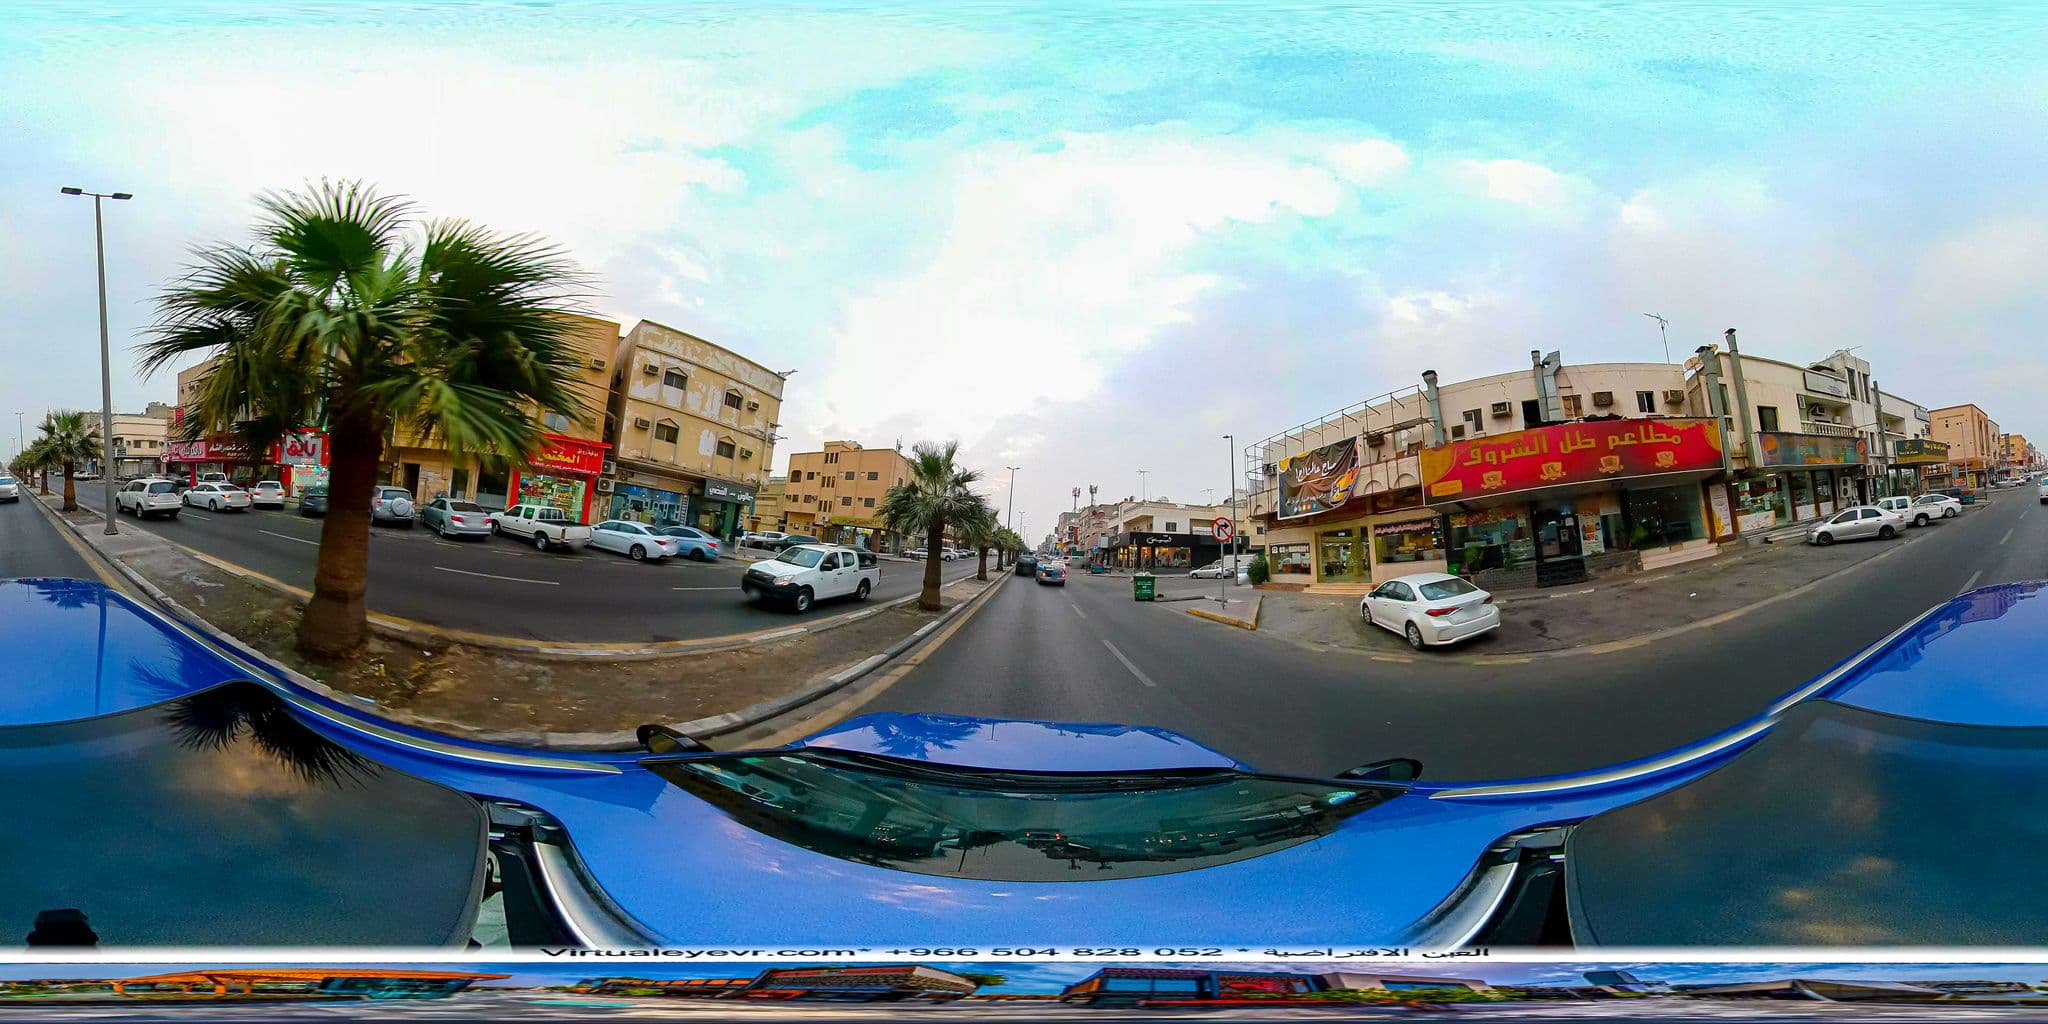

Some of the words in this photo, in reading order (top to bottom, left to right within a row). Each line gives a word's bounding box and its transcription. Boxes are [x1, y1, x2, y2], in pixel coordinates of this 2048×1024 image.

[1463, 434, 1548, 466] الشروق
[1559, 429, 1596, 454] ظل
[1607, 425, 1682, 450] مطاعم
